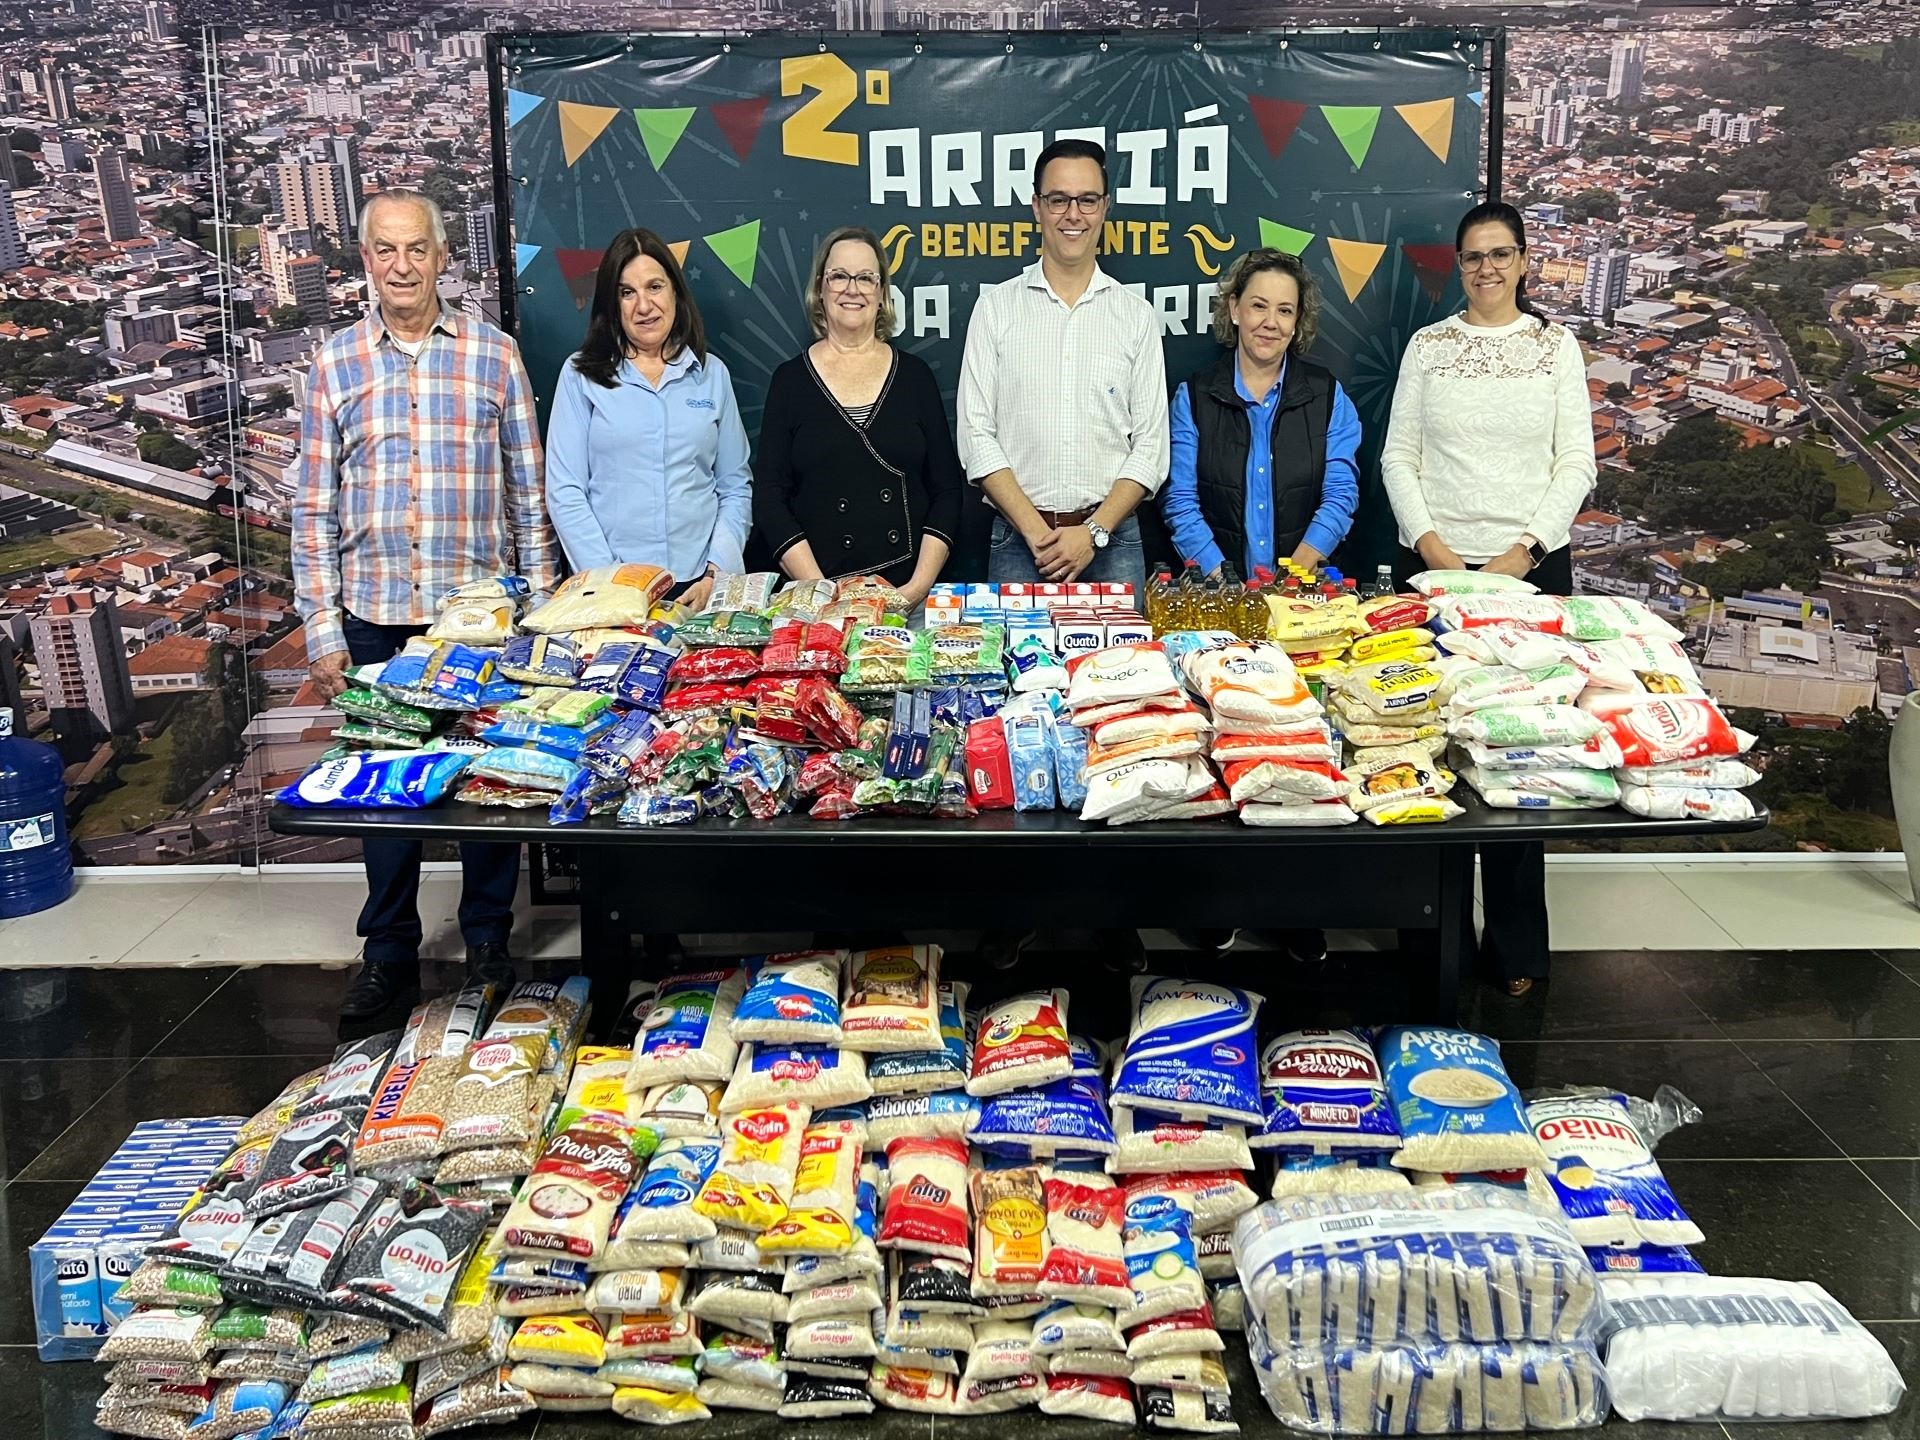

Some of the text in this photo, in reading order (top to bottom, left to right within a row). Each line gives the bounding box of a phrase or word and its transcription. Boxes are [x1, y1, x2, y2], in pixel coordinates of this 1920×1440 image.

[869, 104, 1229, 207] ARRIÁ
[1065, 635, 1099, 649] Quatá
[1278, 1053, 1369, 1074] MINUETO
[867, 1096, 930, 1119] Saborosa
[1310, 1105, 1349, 1121] MINUETO
[1539, 1118, 1638, 1147] união
[641, 1187, 688, 1204] Camil
[1127, 1199, 1173, 1217] Camil
[187, 1211, 241, 1225] oliron
[388, 1244, 445, 1275] oliron
[57, 1261, 87, 1276] atá
[61, 1291, 77, 1300] emi
